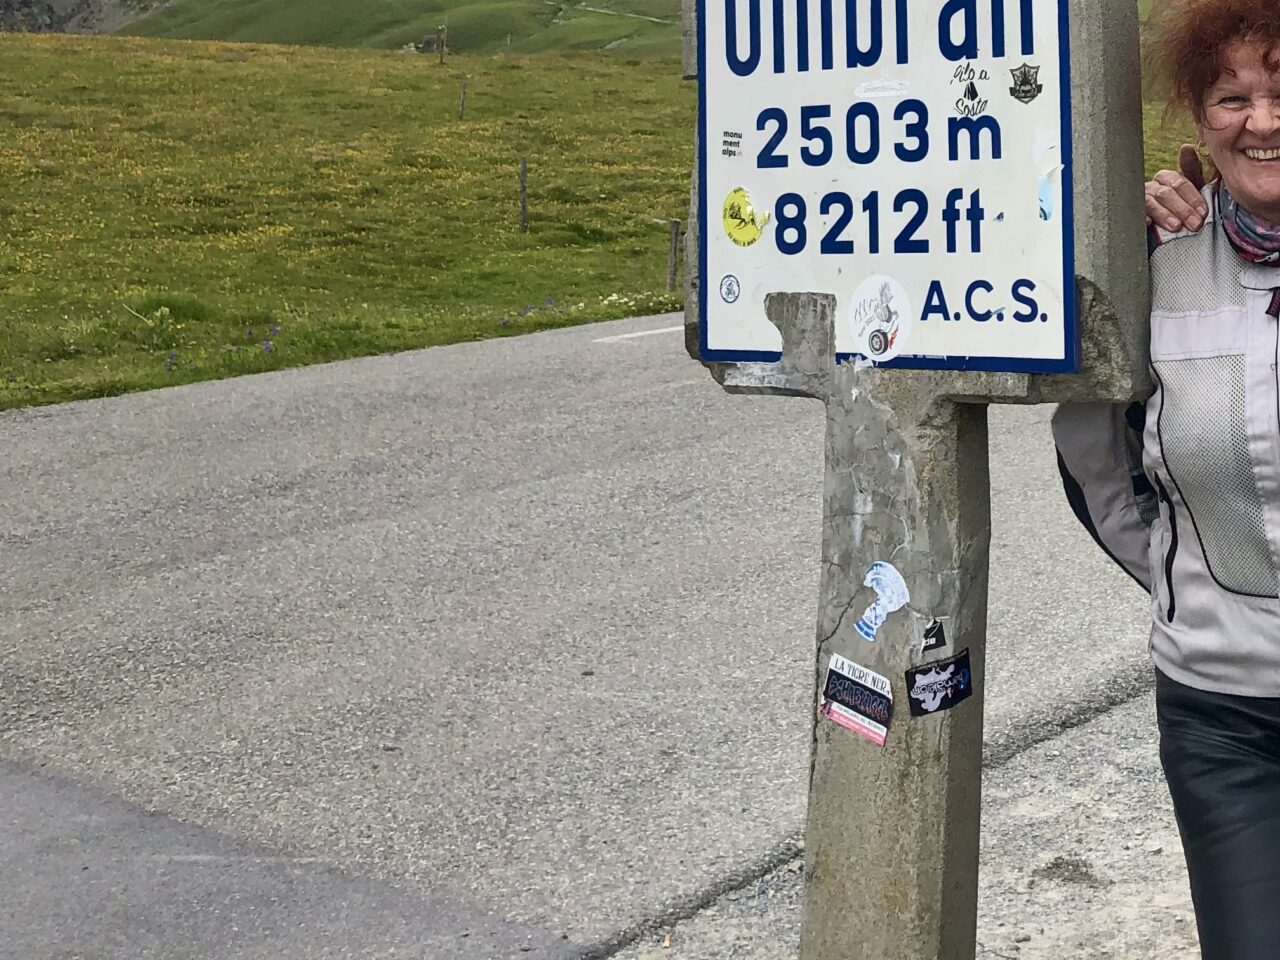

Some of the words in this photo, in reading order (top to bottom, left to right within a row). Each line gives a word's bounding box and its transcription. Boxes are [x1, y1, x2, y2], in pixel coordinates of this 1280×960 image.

[723, 131, 742, 139] monu
[757, 99, 929, 170] 2503
[948, 114, 1002, 162] m
[722, 140, 740, 148] ment
[721, 147, 736, 157] alps
[774, 188, 930, 256] 8212
[942, 187, 985, 254] ft
[920, 278, 1048, 323] A.C.S.
[835, 658, 845, 672] LA
